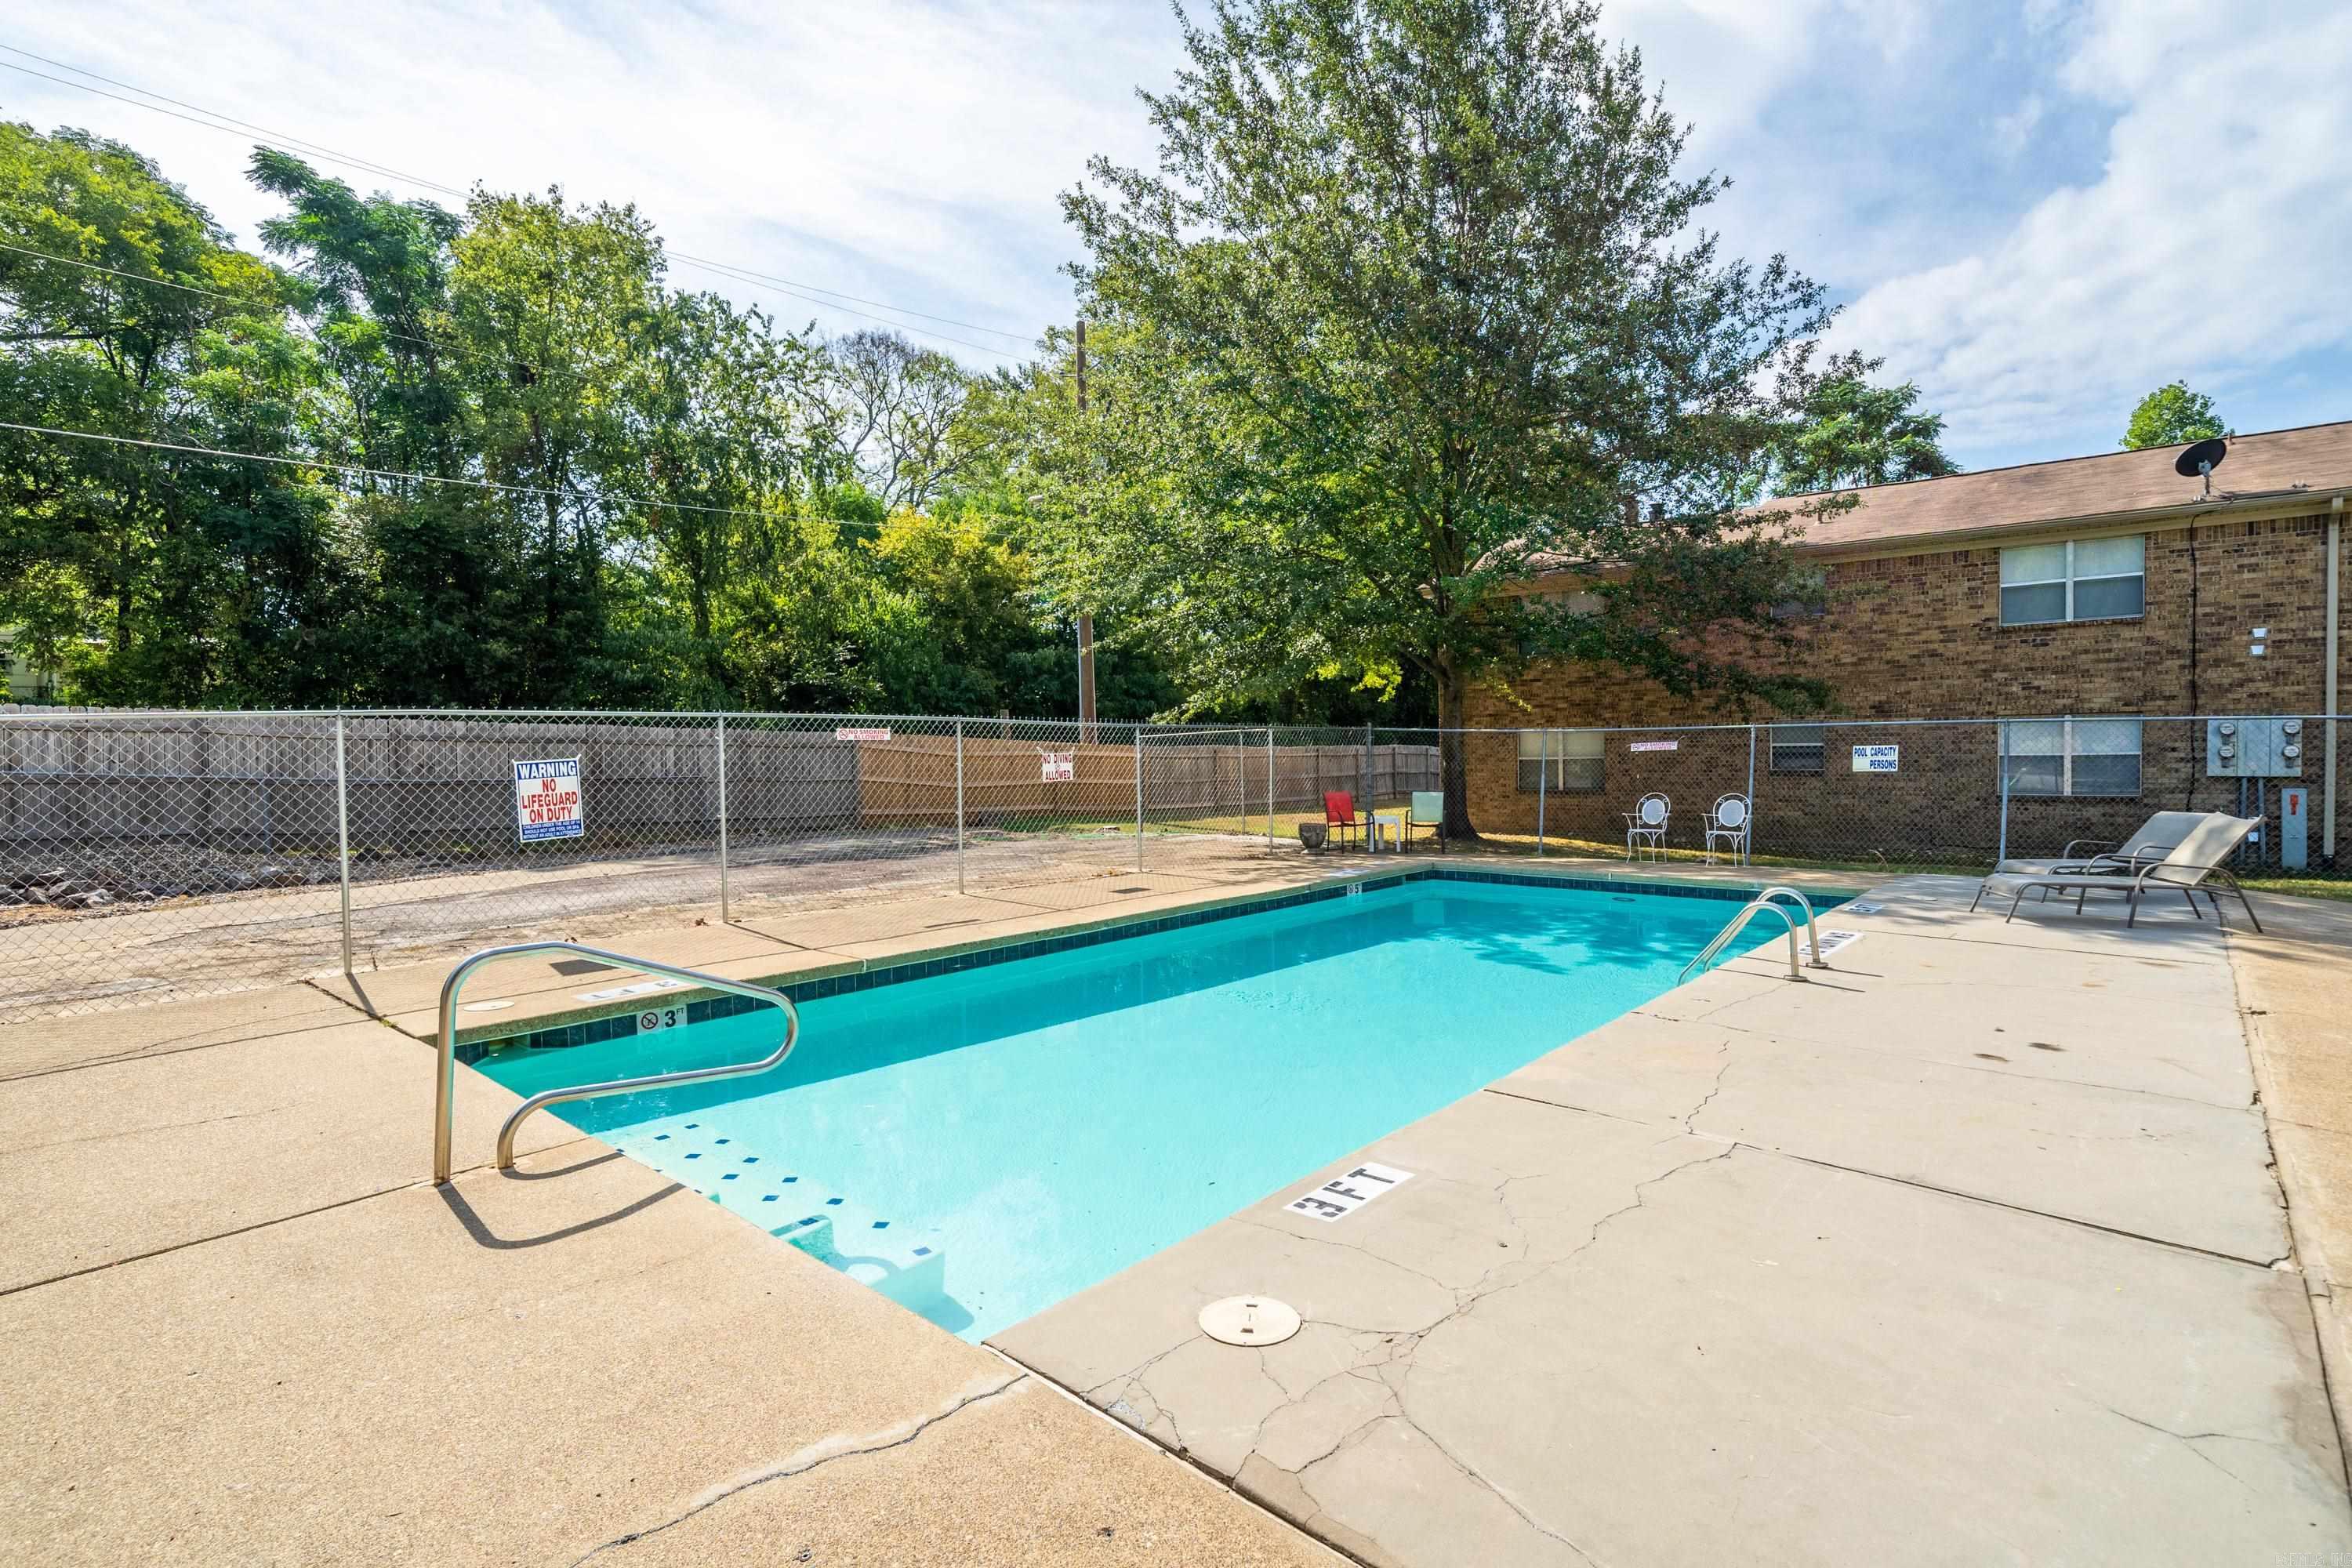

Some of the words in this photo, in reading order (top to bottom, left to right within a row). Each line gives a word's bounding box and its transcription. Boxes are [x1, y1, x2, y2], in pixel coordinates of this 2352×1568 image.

[1854, 747, 1867, 757] POOL
[1870, 746, 1896, 757] CAPACITY
[1044, 754, 1051, 764] NO
[1054, 753, 1072, 764] DIVING
[1870, 759, 1896, 770] PERSONS
[518, 761, 576, 779] WARNING
[1045, 770, 1071, 780] ALLOWED
[542, 779, 557, 793] NO
[521, 791, 578, 809] LIFEGUARD
[529, 808, 543, 823] ON
[547, 806, 572, 822] DUTY
[1355, 884, 1359, 894] 5
[664, 1010, 676, 1028] 3
